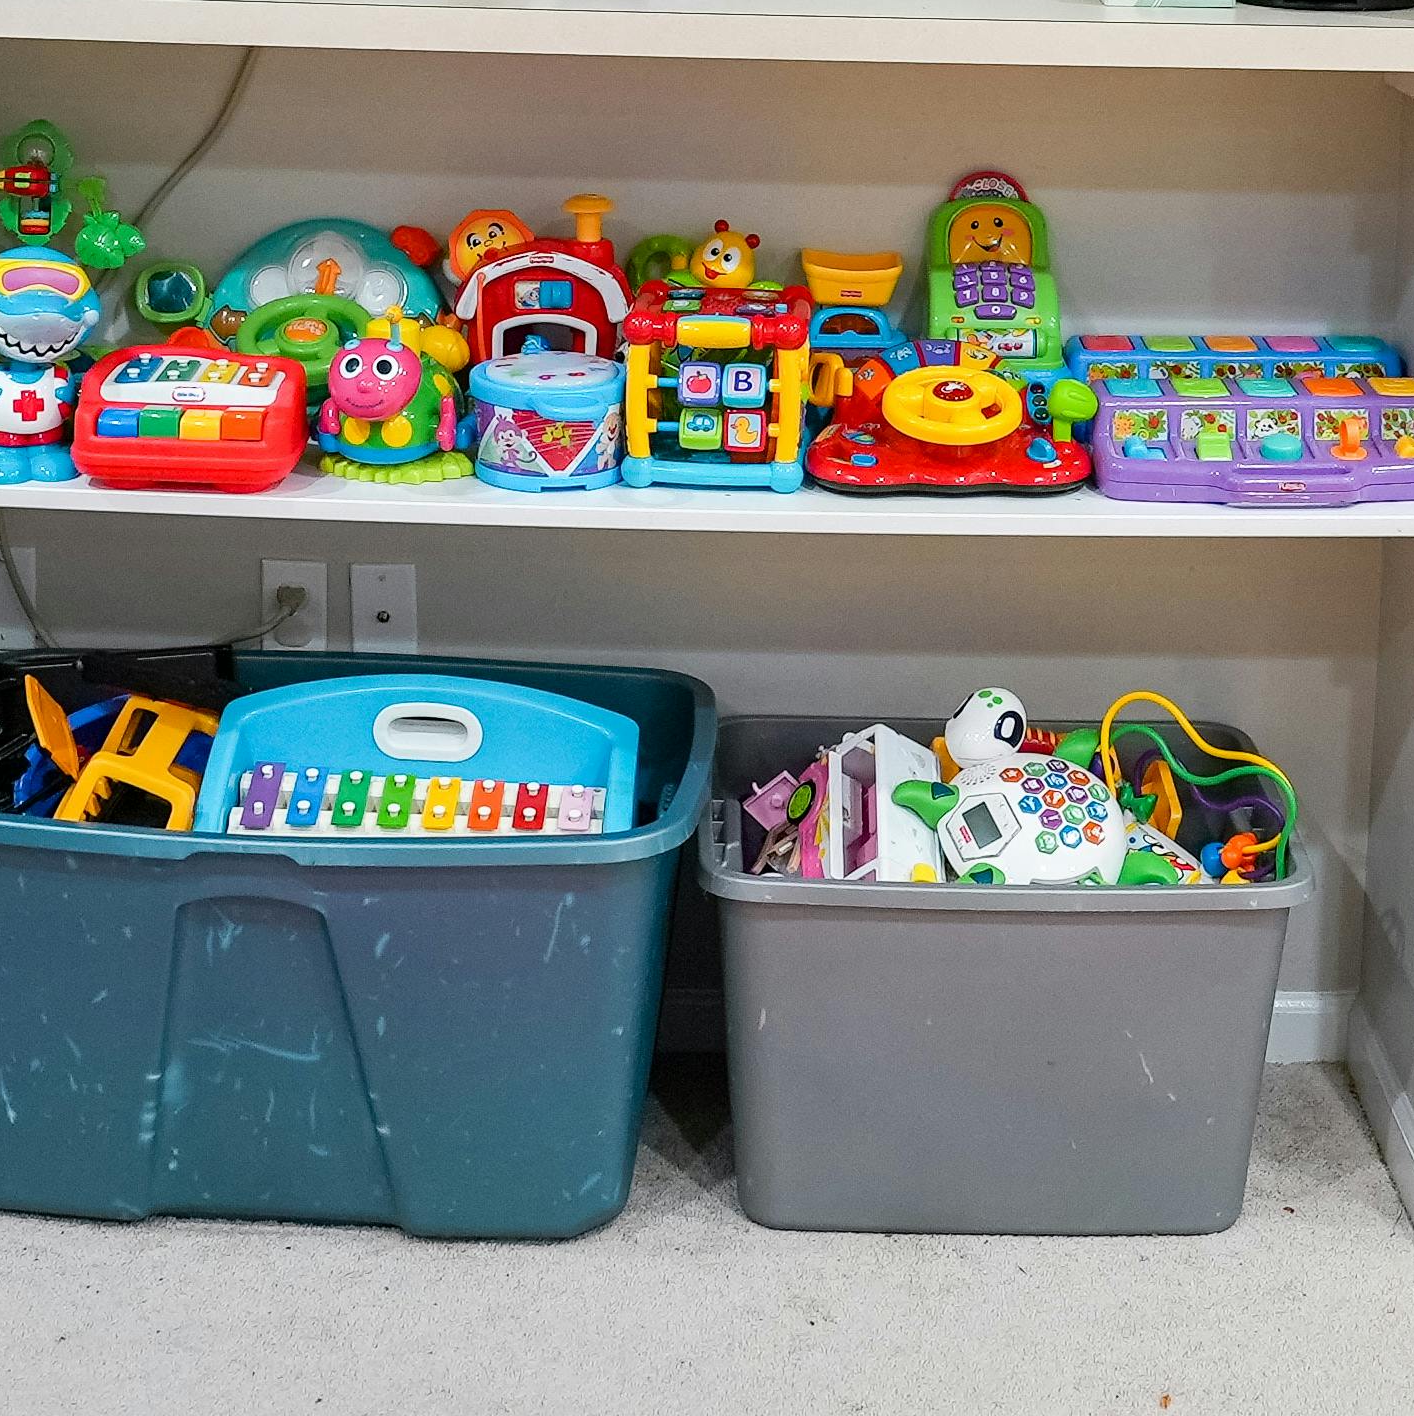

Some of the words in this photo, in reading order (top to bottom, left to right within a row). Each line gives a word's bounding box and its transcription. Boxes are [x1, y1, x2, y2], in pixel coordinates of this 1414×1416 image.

[1019, 276, 1028, 284] 6
[963, 290, 972, 300] 7
[992, 288, 1000, 297] 8
[1019, 292, 1029, 301] 9
[734, 370, 753, 392] B
